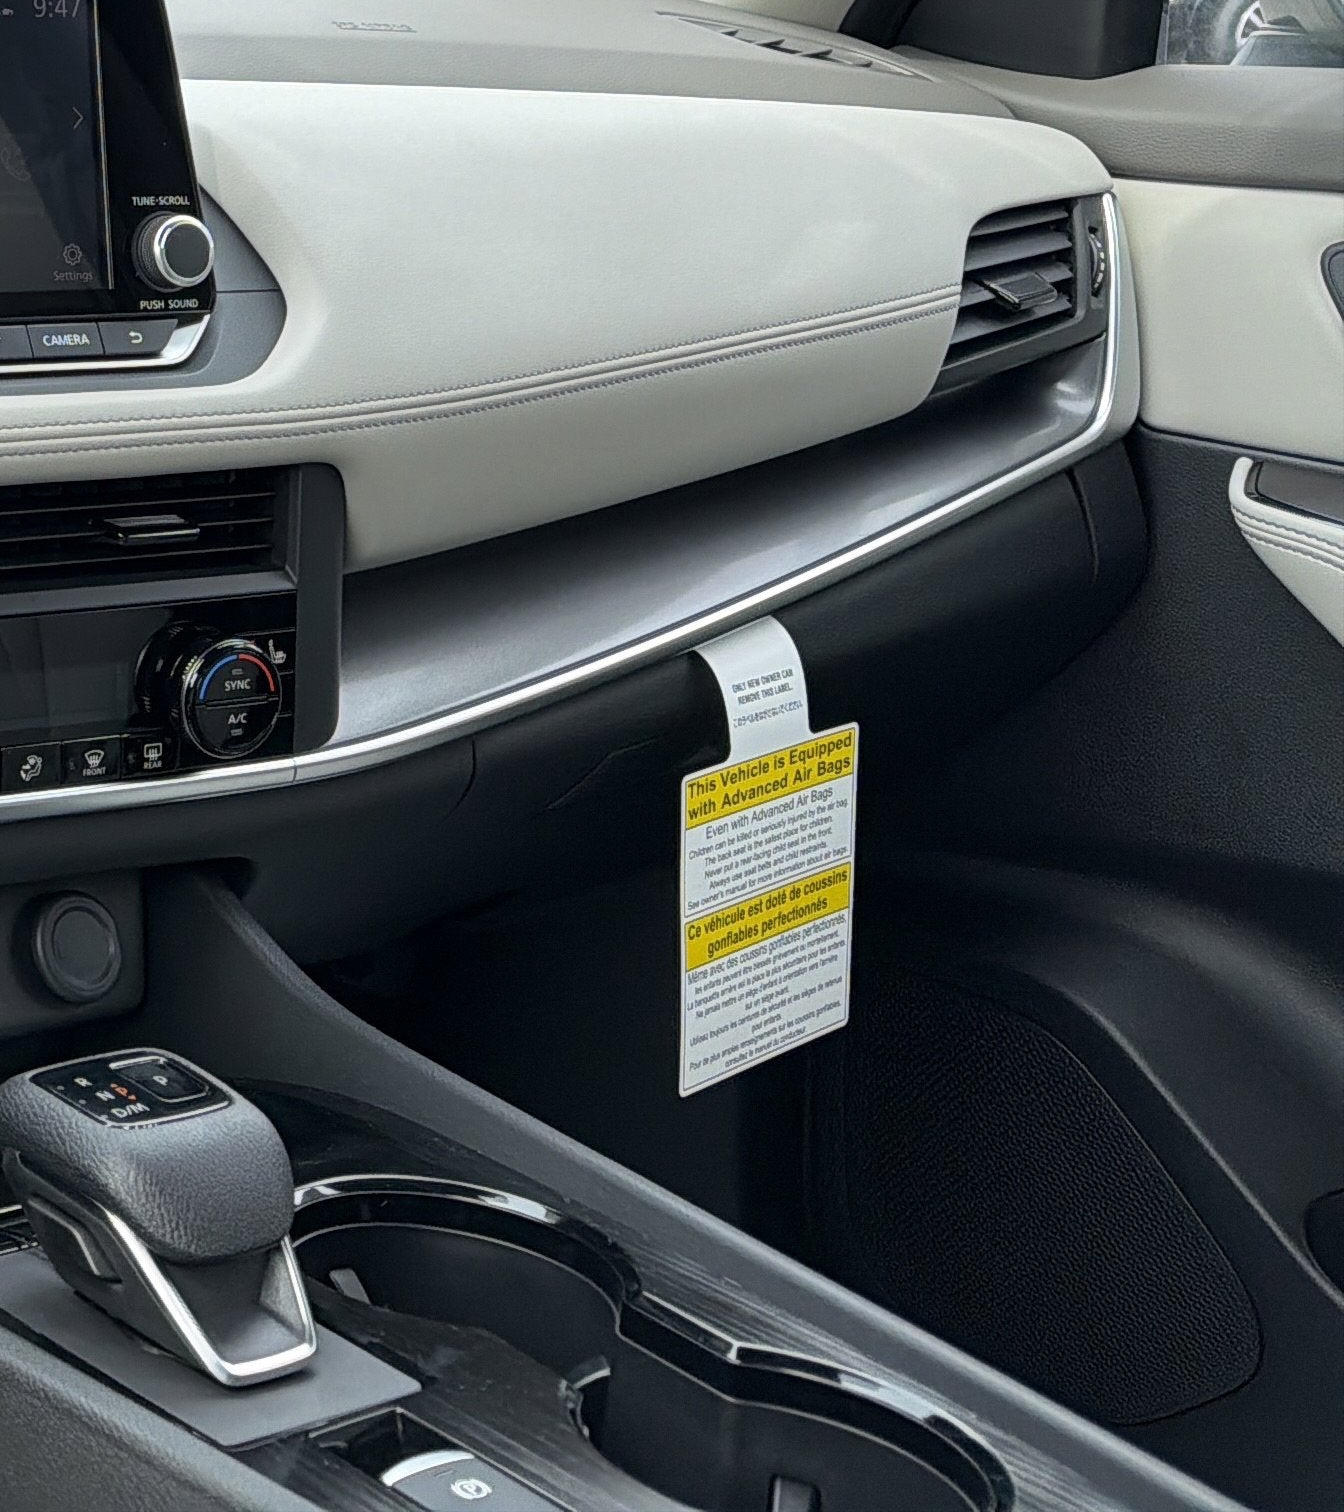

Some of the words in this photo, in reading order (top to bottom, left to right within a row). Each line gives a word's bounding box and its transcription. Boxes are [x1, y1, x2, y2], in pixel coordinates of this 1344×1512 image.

[53, 269, 93, 283] Settings
[140, 300, 165, 310] PUSH
[168, 298, 199, 309] SOUND
[42, 333, 91, 348] CAMERA
[224, 678, 252, 692] SYNC
[228, 712, 249, 725] A/C
[143, 760, 163, 770] REAR
[687, 779, 716, 797] This
[720, 761, 769, 786] Vehicle
[773, 756, 785, 769] is
[788, 732, 852, 764] Equipped
[82, 767, 107, 777] FRONT
[688, 799, 716, 819] with
[721, 773, 788, 808] Advanced
[792, 767, 812, 784] Air
[816, 756, 851, 776] Bags
[705, 822, 729, 839] Even
[730, 814, 749, 829] with
[751, 798, 794, 822] Advanced
[796, 794, 808, 807] Air
[810, 787, 833, 802] Bags
[687, 924, 701, 940] Ce
[704, 907, 745, 933] véhicule
[747, 899, 763, 916] est
[765, 890, 787, 910] doté
[789, 886, 801, 900] de
[803, 870, 847, 895] coussins
[707, 924, 759, 957] gonflables
[761, 897, 827, 934] perfectionnés
[74, 1077, 92, 1087] R
[152, 1075, 168, 1086] P
[95, 1090, 115, 1102] N
[111, 1102, 150, 1119] D/M
